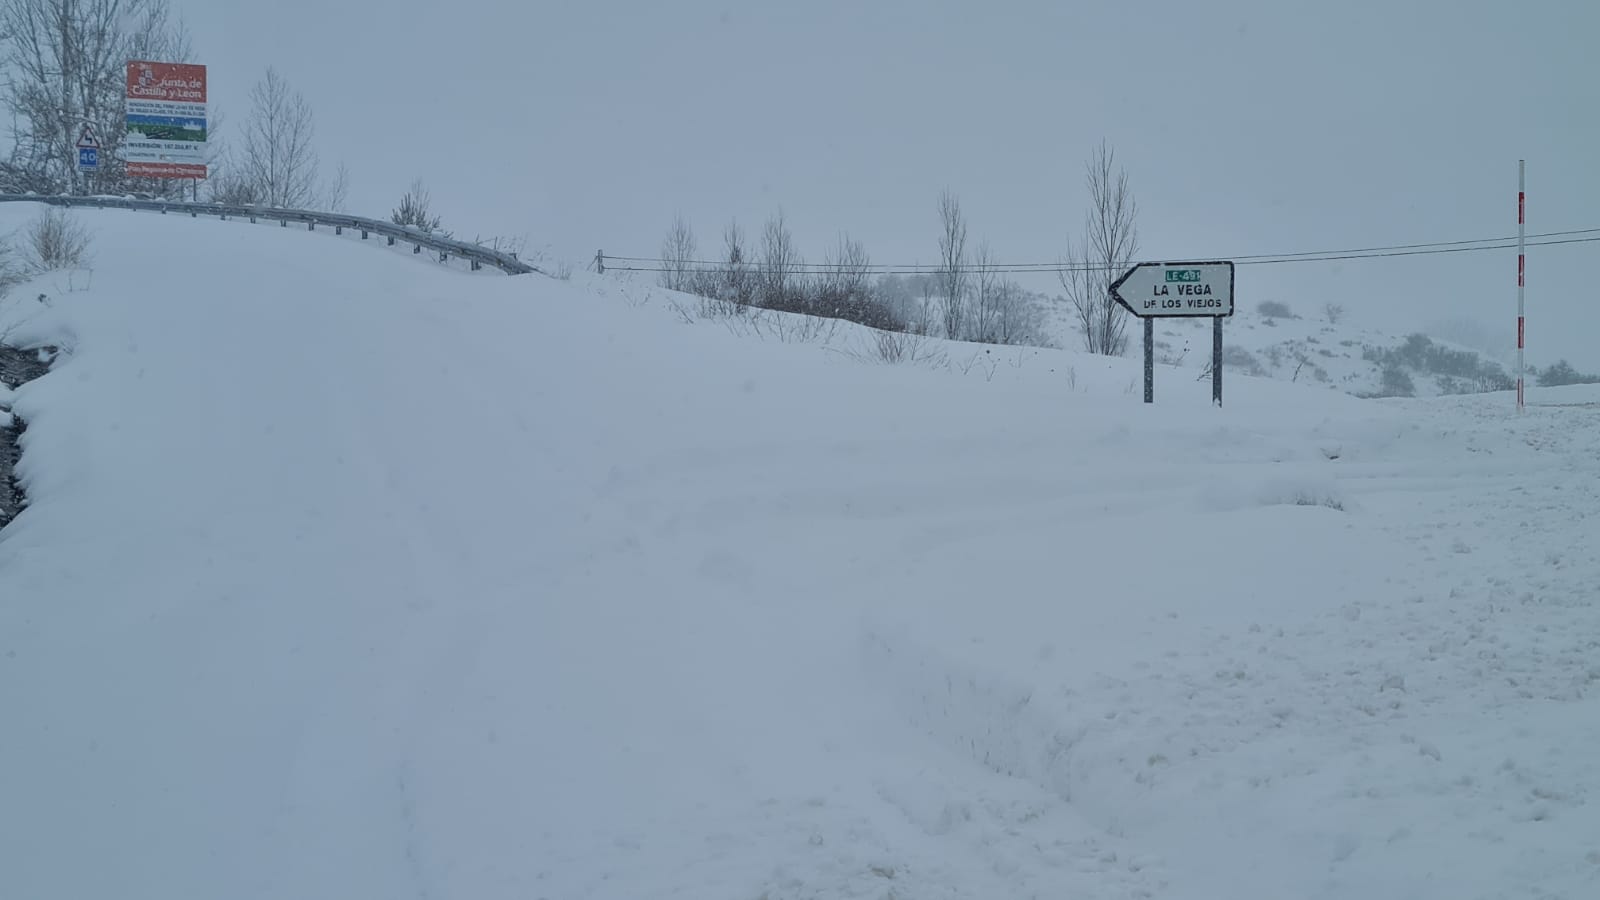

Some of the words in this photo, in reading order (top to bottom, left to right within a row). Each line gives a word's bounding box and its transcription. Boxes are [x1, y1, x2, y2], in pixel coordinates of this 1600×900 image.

[158, 79, 188, 89] Junta
[189, 79, 202, 89] de
[132, 85, 167, 97] Castilla
[169, 89, 176, 98] y
[80, 153, 96, 162] 40
[1153, 284, 1169, 296] LA
[1177, 284, 1212, 296] VEGA
[1161, 299, 1182, 309] LOS
[1187, 299, 1222, 308] VIEJOS
